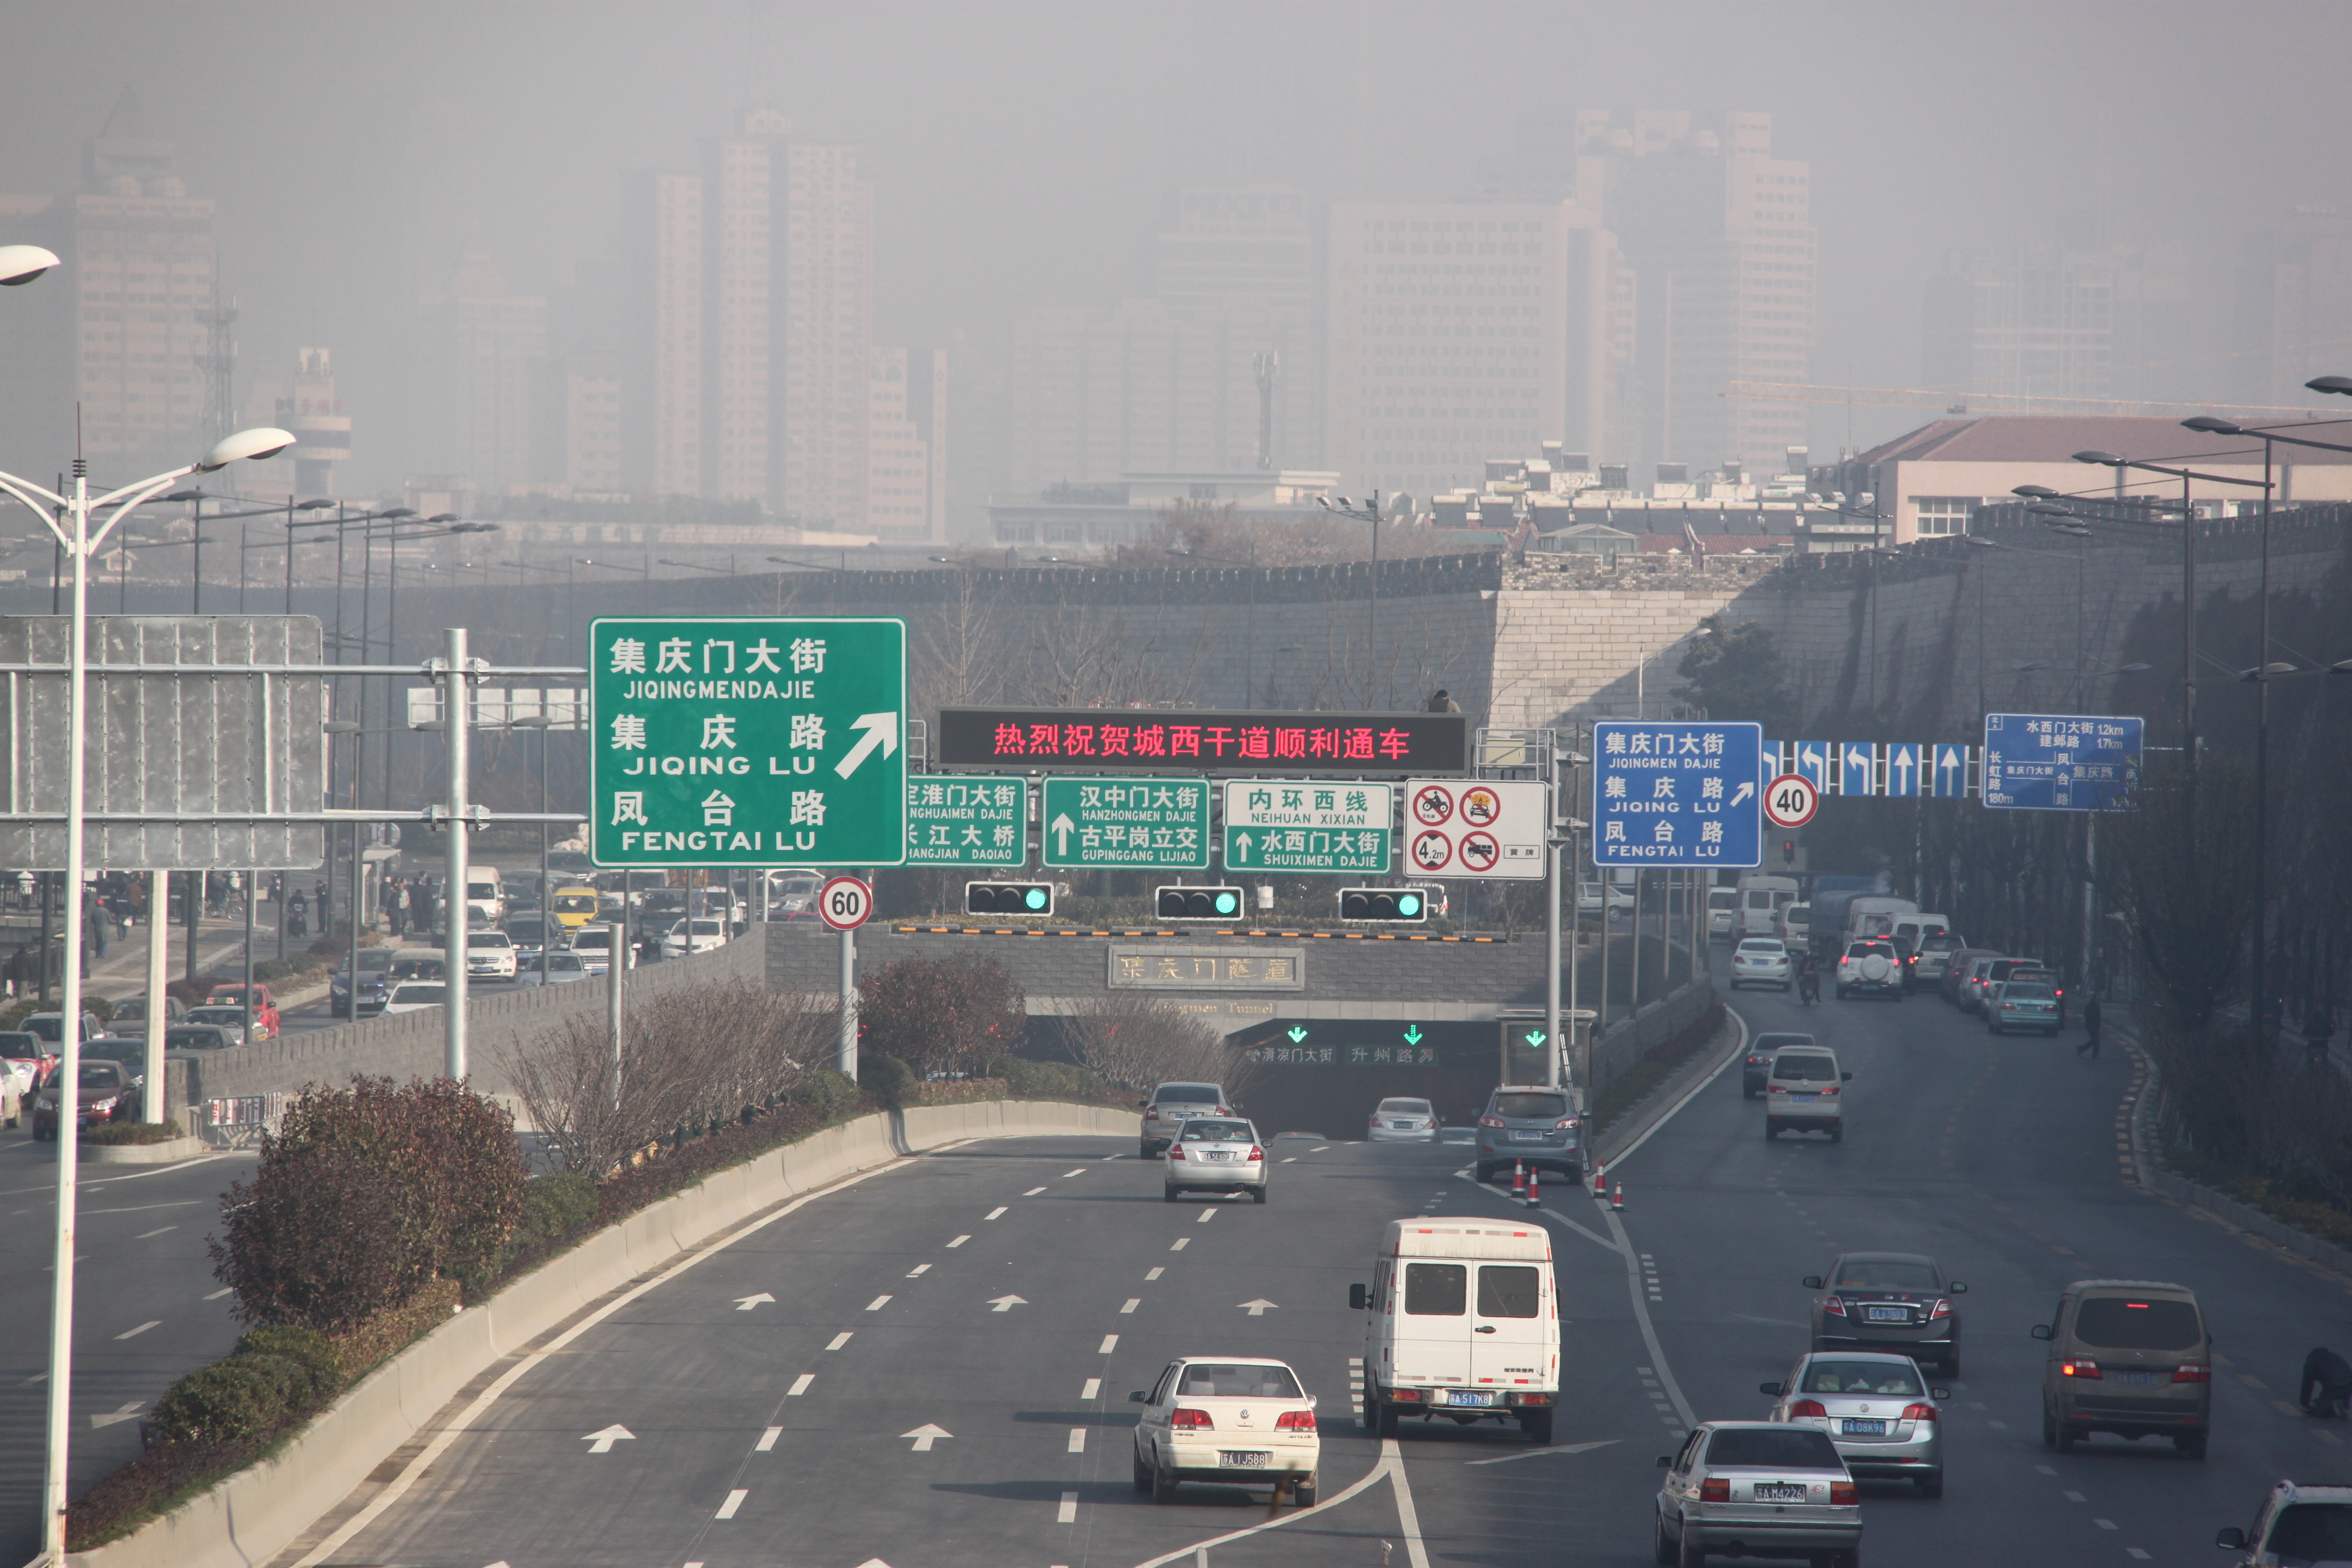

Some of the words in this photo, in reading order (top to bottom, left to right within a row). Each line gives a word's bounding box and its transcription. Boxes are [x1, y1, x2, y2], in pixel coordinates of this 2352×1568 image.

[610, 637, 827, 675] 集庆门大街
[623, 680, 815, 699] JIQINGMENDAJIE
[610, 713, 827, 750] 集庆路
[2027, 720, 2094, 735] 水西门大街
[993, 723, 1411, 760] 热烈祝贺城西干道顺利通车
[1605, 732, 1724, 755] 集庆门大街
[623, 756, 750, 776] JIQING
[770, 756, 815, 775] LU
[1609, 757, 1677, 769] JIQINGMEN
[1684, 758, 1720, 769] DAJIE
[1989, 750, 2002, 791] 长虹路
[2007, 766, 2054, 776] 集庆门大街
[1080, 785, 1199, 809] 汉中门大街
[1605, 776, 1724, 799] 集庆路
[611, 789, 827, 826] 凤台路
[1249, 788, 1368, 812] 内环西线
[1609, 801, 1680, 813] JIQING
[1694, 802, 1720, 813] LU
[1776, 789, 1804, 813] 40
[1988, 793, 2013, 804] 180m
[981, 808, 1013, 820] DAJIE
[1082, 809, 1160, 822] HANZHONGMEN
[1166, 811, 1196, 822] DAJIE
[1252, 813, 1311, 824] NEIHUAN
[1321, 814, 1365, 825] XIXIAN
[623, 831, 761, 851] FENGTAI
[776, 831, 815, 850] LU
[1079, 825, 1198, 851] 古平岗立交
[1605, 820, 1723, 843] 凤台路
[1261, 830, 1380, 854] 水西门大街
[1419, 841, 1444, 859] 4.2m
[1608, 845, 1683, 856] FENGTAI
[1695, 845, 1719, 857] LU
[972, 849, 1012, 860] DAQIAO
[1082, 849, 1154, 861] GUPINGGANG
[1160, 851, 1196, 862] LIJIAO
[1264, 854, 1332, 866] SHUIXIMEN
[1340, 855, 1377, 867] DAJIE
[832, 891, 859, 916] 60
[1120, 955, 1295, 982] 集庆门隧道
[1226, 1002, 1274, 1014] Tunnel
[1351, 1046, 1415, 1063] 升州路
